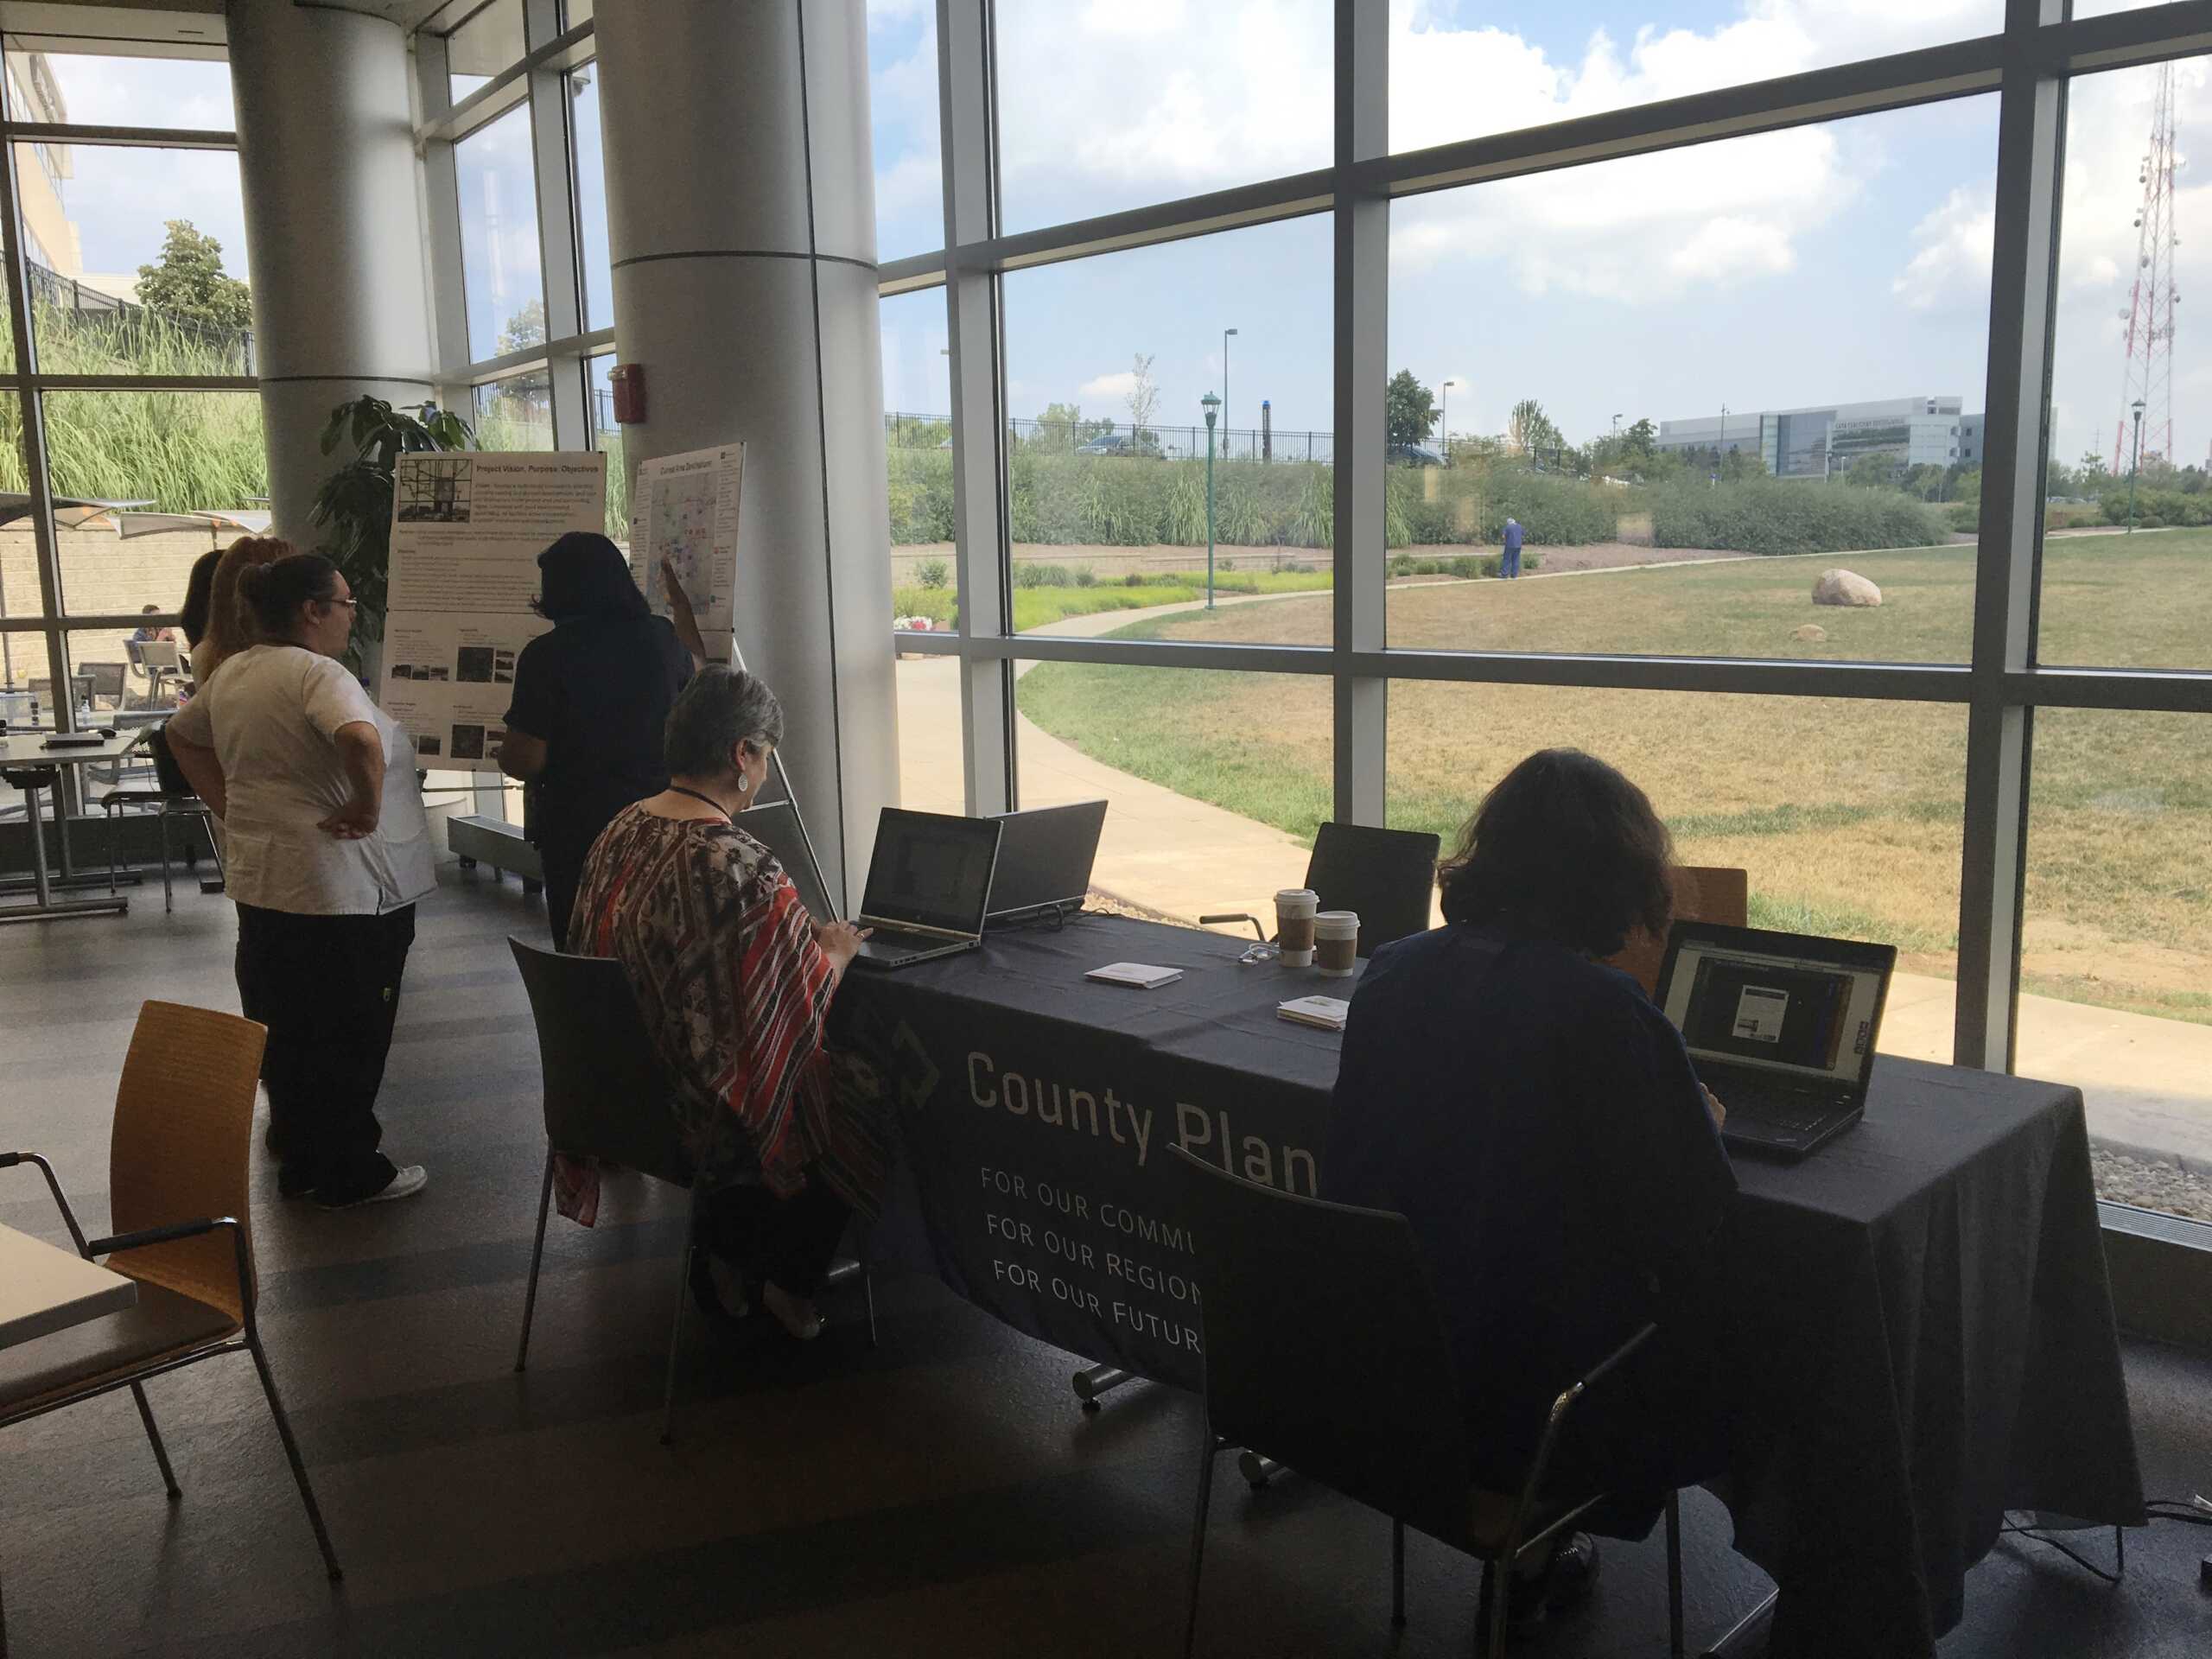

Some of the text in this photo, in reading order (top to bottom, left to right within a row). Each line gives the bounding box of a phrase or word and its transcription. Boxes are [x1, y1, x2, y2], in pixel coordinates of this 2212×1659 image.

[476, 465, 501, 474] Project
[561, 465, 599, 474] Objectives
[968, 1051, 1318, 1198] County Plan
[981, 1166, 1028, 1199] FOR
[1039, 1182, 1090, 1220] OUR
[988, 1214, 1033, 1247] FOR
[1045, 1230, 1095, 1270] OUR
[994, 1260, 1202, 1355] FOR OUR FUTUR
